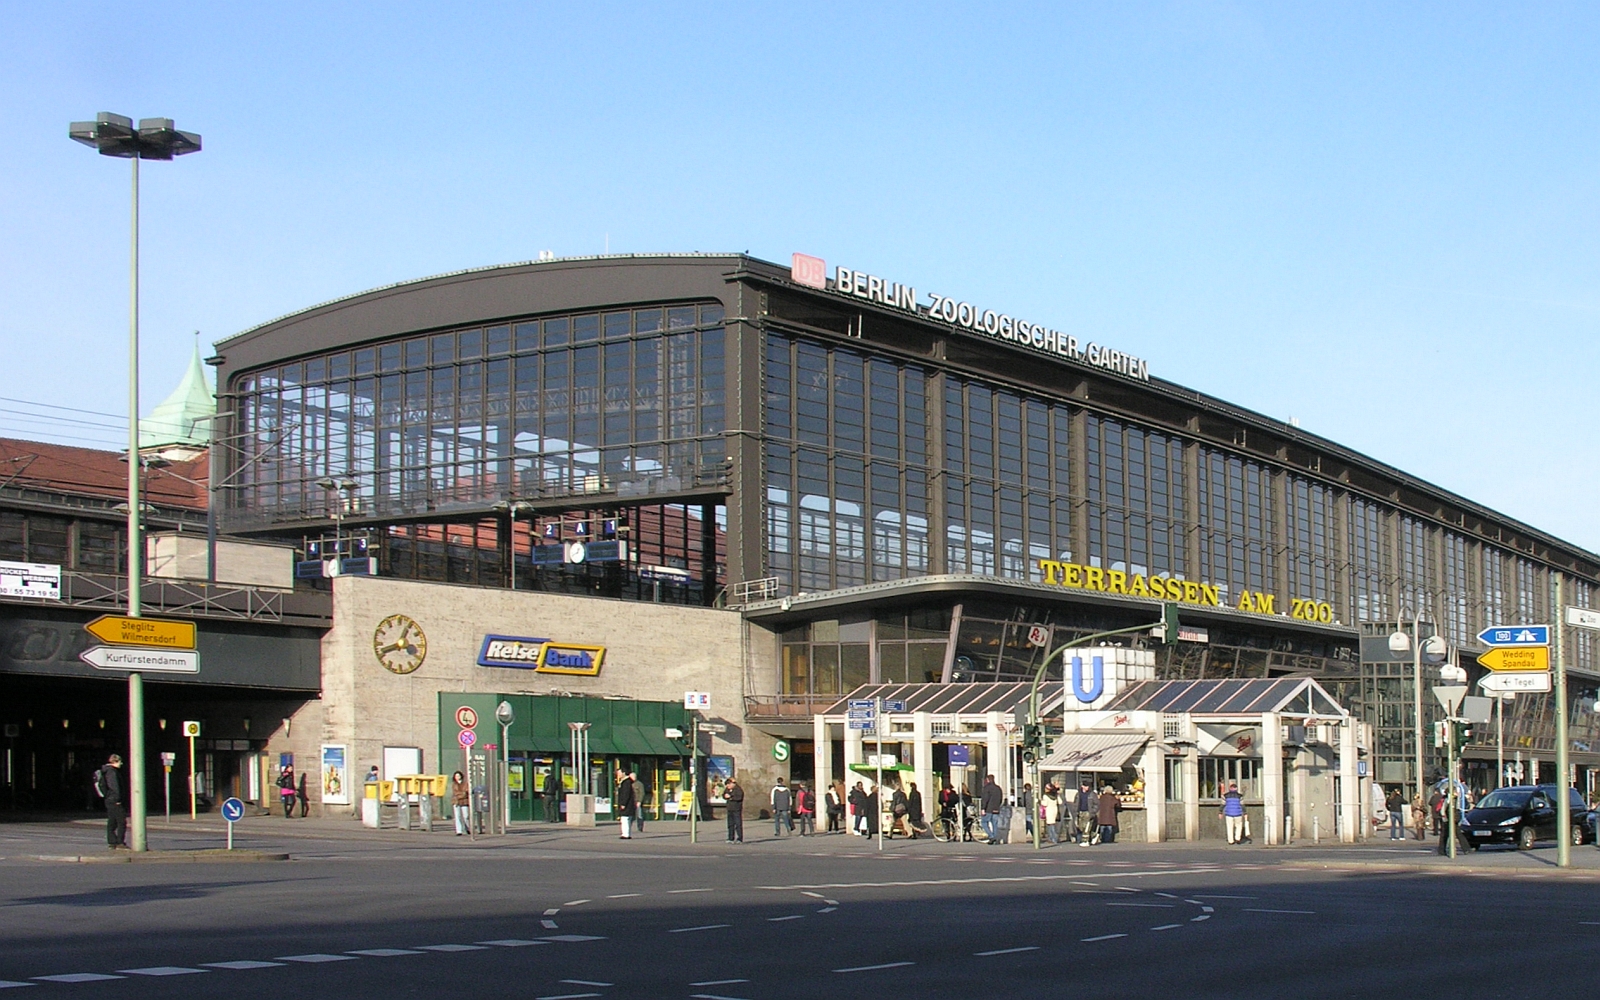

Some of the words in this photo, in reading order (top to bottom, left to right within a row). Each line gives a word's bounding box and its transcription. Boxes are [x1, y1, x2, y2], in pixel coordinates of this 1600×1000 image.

[799, 259, 822, 284] DB
[836, 266, 917, 311] BERLIN
[928, 292, 1080, 359] ZOOLOGISCHER
[1086, 341, 1149, 381] GARTEN
[545, 524, 553, 535] 2
[576, 522, 584, 533] A
[610, 520, 615, 531] 1
[309, 543, 316, 552] 4
[360, 538, 367, 548] 3
[23, 575, 58, 584] WERBUNG
[1039, 559, 1221, 606] TERRASSEN
[1238, 590, 1275, 615] AM
[1291, 598, 1333, 624] ZOO
[121, 621, 155, 632] Steglitz
[121, 632, 176, 643] Wilmersdorf
[106, 653, 187, 666] Kurfürstendamm
[486, 641, 539, 660] Reise
[546, 648, 594, 668] Bank
[1502, 651, 1535, 660] Wedding
[1502, 660, 1536, 668] Spandau
[1071, 656, 1104, 703] U
[1514, 678, 1535, 687] Tegel
[774, 741, 788, 760] S
[1359, 762, 1365, 774] U
